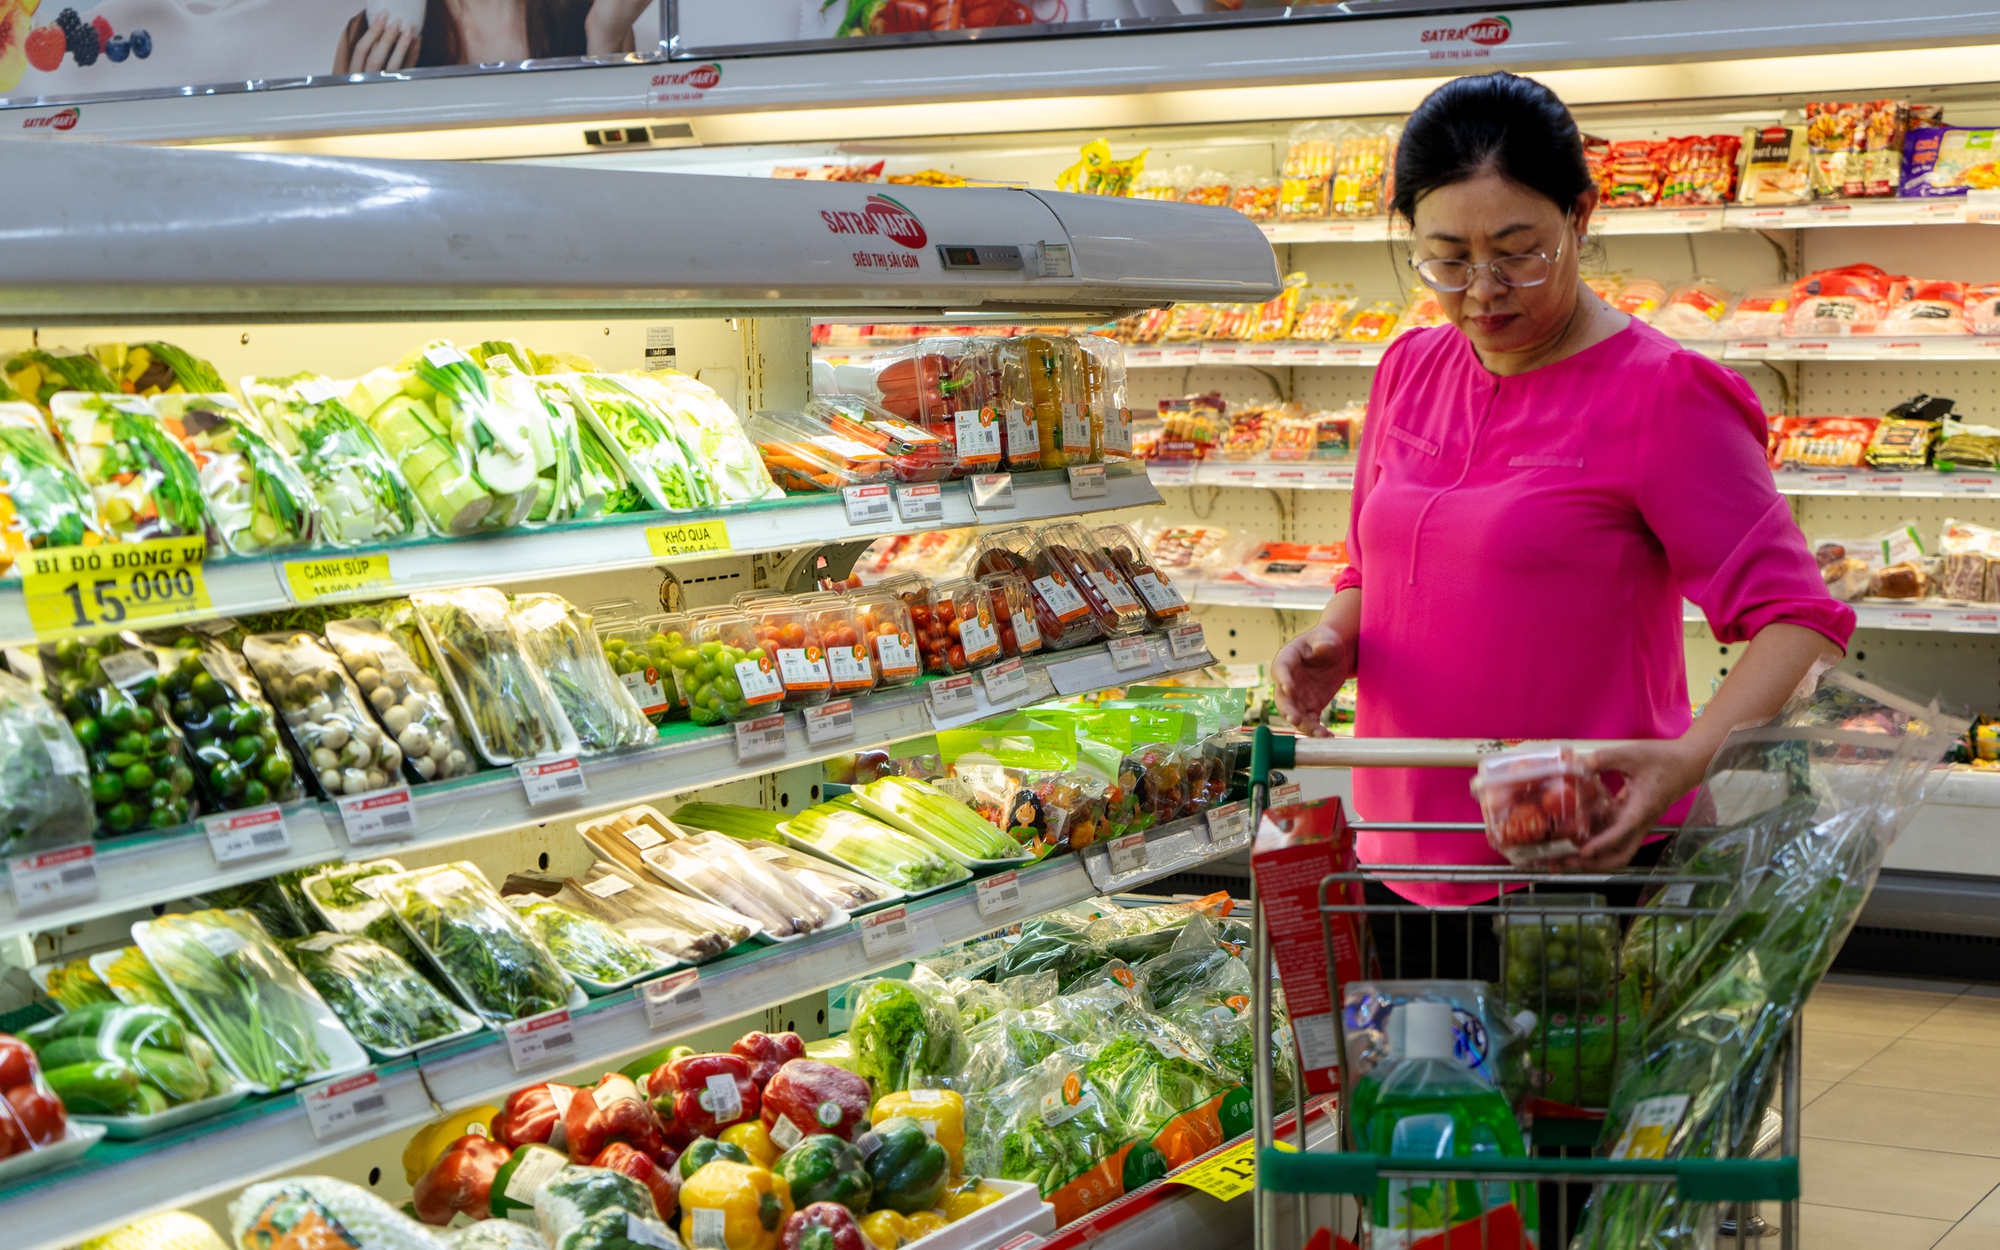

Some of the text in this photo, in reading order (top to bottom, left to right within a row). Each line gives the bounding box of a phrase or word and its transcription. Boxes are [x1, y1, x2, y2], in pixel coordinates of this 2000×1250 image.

[1421, 25, 1505, 42] SATRAMART
[651, 71, 717, 87] SATRAMART
[22, 115, 76, 129] SATRAMART
[821, 209, 920, 240] SATRAMART
[853, 253, 919, 272] SIÊU THỊ SÀI GÒN
[688, 528, 711, 542] QUA
[303, 557, 370, 580] CANH SÚP
[63, 568, 194, 628] 15.000
